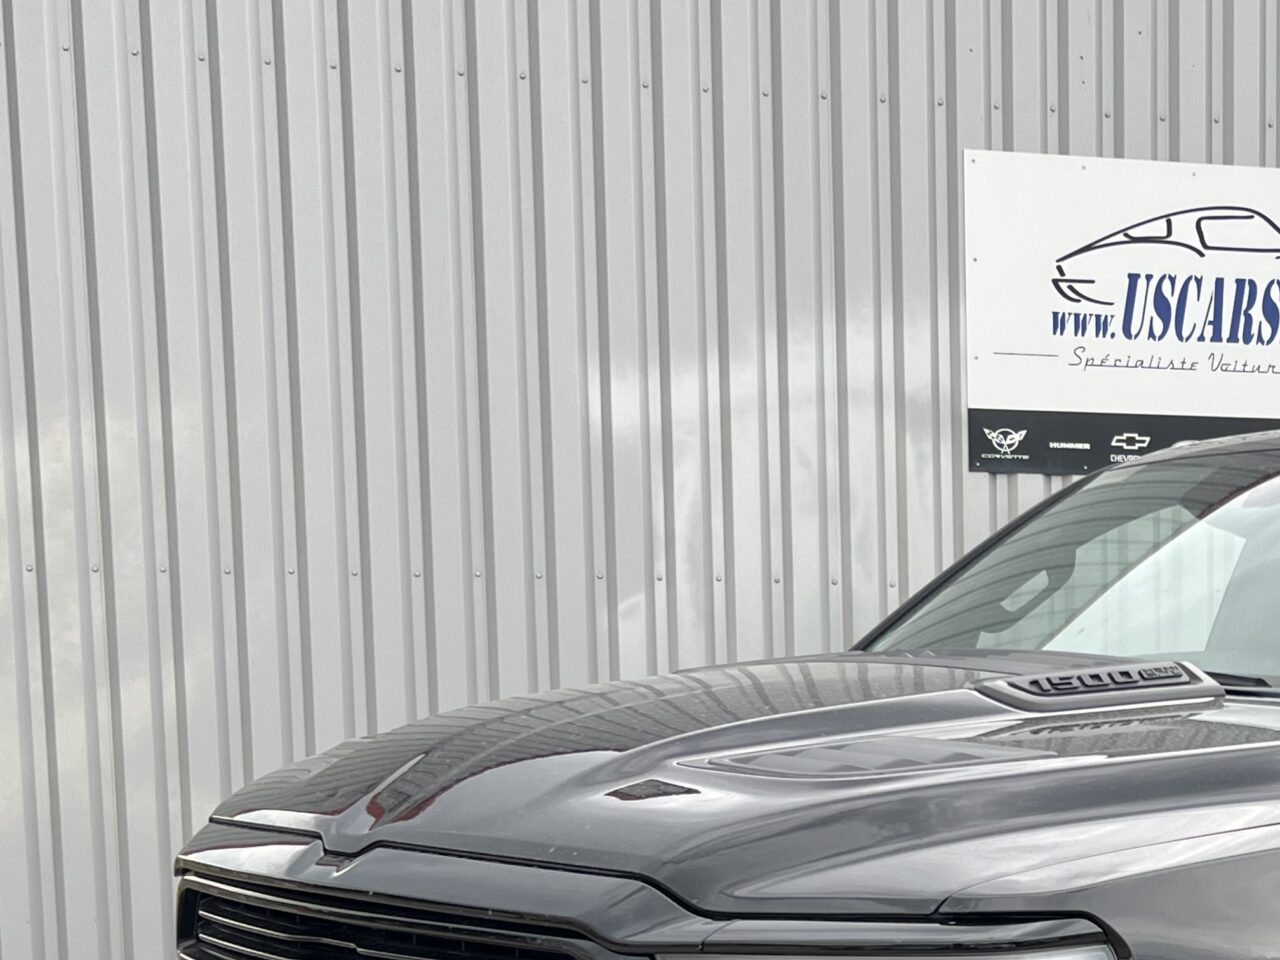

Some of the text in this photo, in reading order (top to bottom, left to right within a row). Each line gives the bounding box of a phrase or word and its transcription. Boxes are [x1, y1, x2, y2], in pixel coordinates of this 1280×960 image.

[1068, 346, 1199, 372] Spécialiste
[1049, 442, 1091, 450] HUMMER
[1029, 669, 1141, 693] 1500
